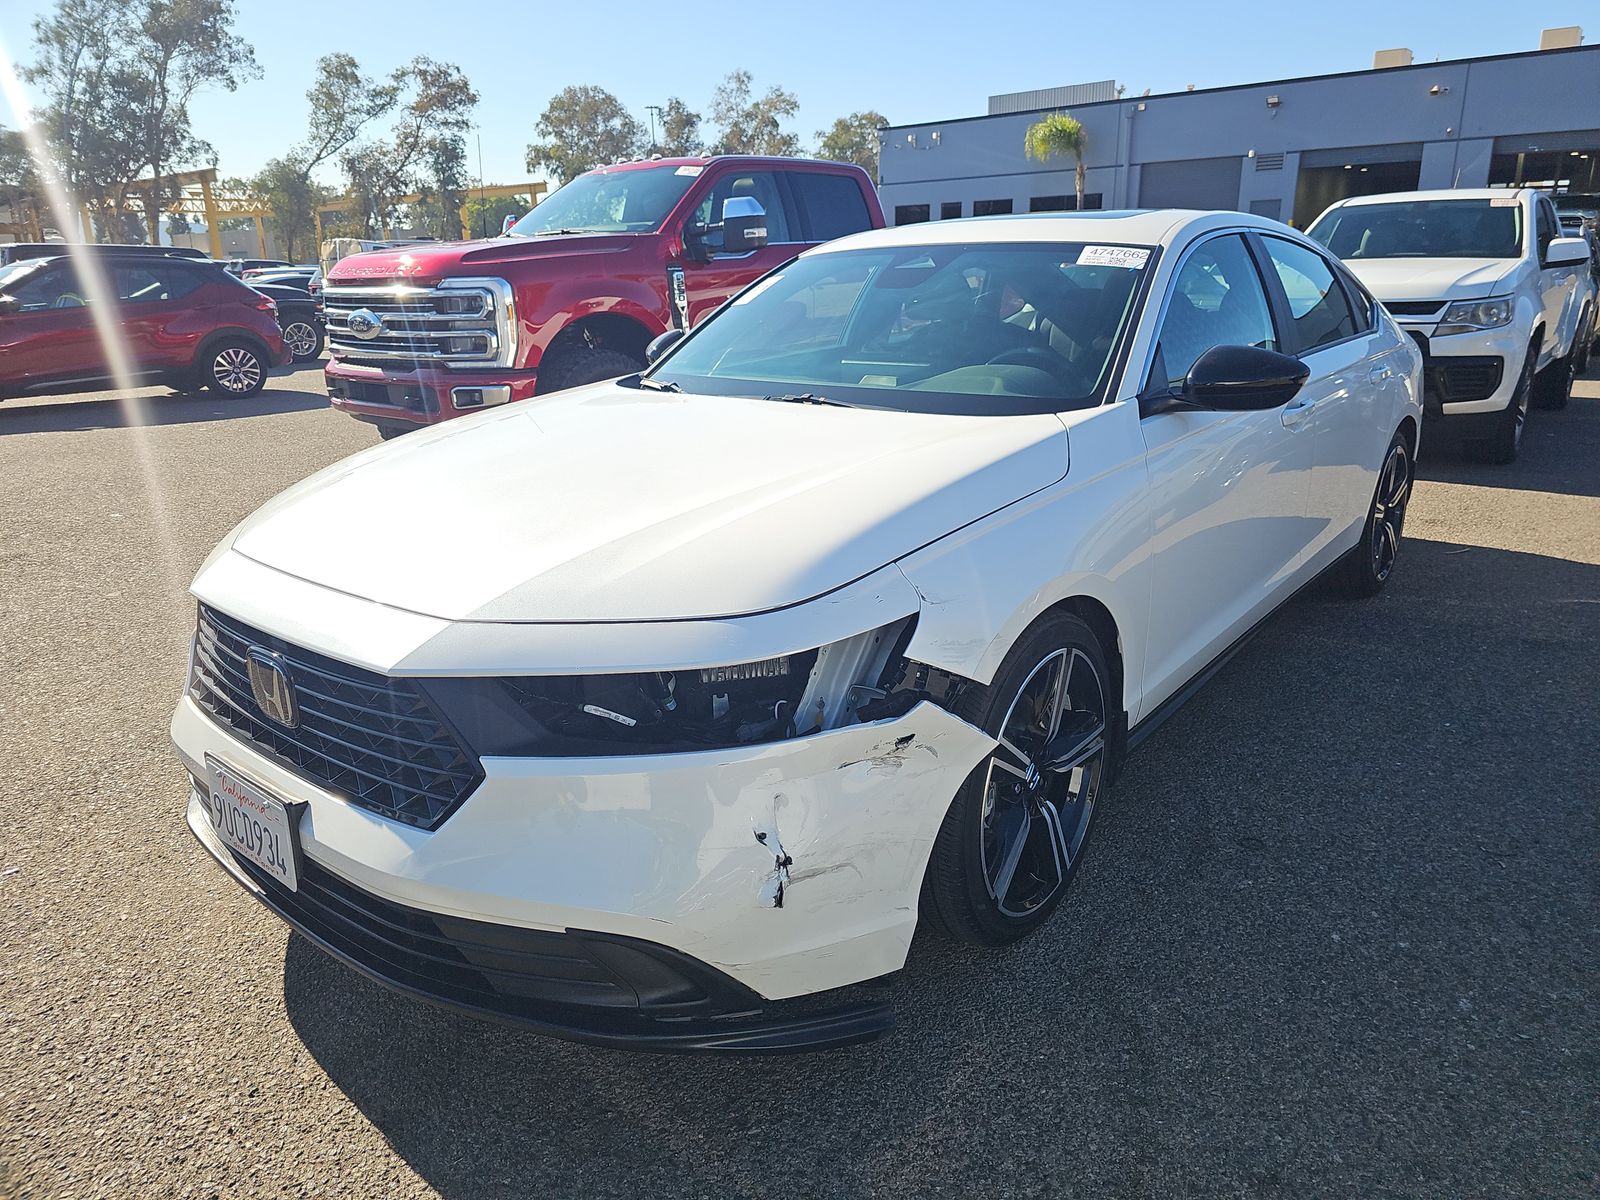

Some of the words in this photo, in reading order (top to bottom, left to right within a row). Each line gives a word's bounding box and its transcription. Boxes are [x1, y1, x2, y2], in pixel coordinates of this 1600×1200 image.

[1090, 248, 1149, 260] 4747662
[220, 775, 266, 815] California
[213, 793, 287, 876] 9UCD934
